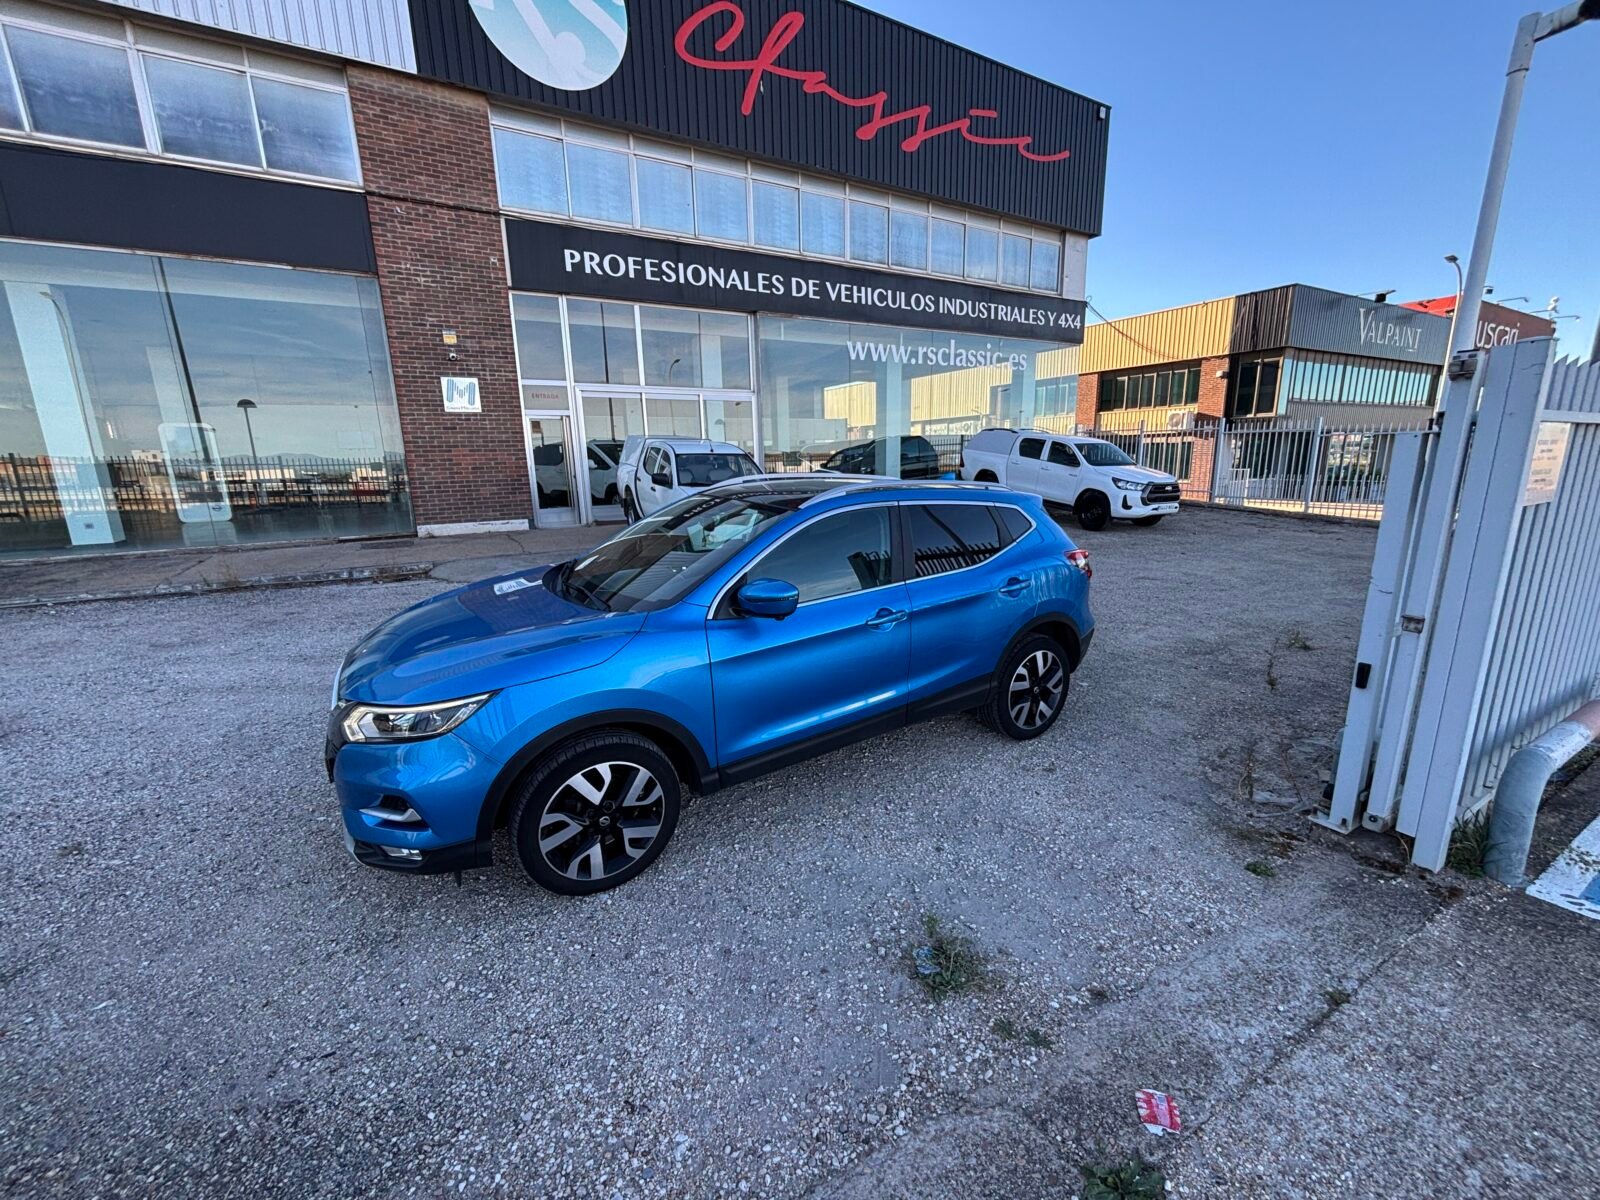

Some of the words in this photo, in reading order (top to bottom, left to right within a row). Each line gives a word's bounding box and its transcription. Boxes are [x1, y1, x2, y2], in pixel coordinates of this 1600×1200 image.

[674, 1, 1070, 162] Classic
[564, 249, 785, 296] PROFESIONALES
[791, 277, 821, 299] DE
[826, 281, 935, 312] VEHICULOS
[939, 296, 1045, 326] INDUSTRIALES
[1047, 312, 1057, 327] Y
[1058, 313, 1082, 330] 4X4
[847, 339, 1028, 370] www.rsclassices
[1475, 320, 1521, 349] uscari
